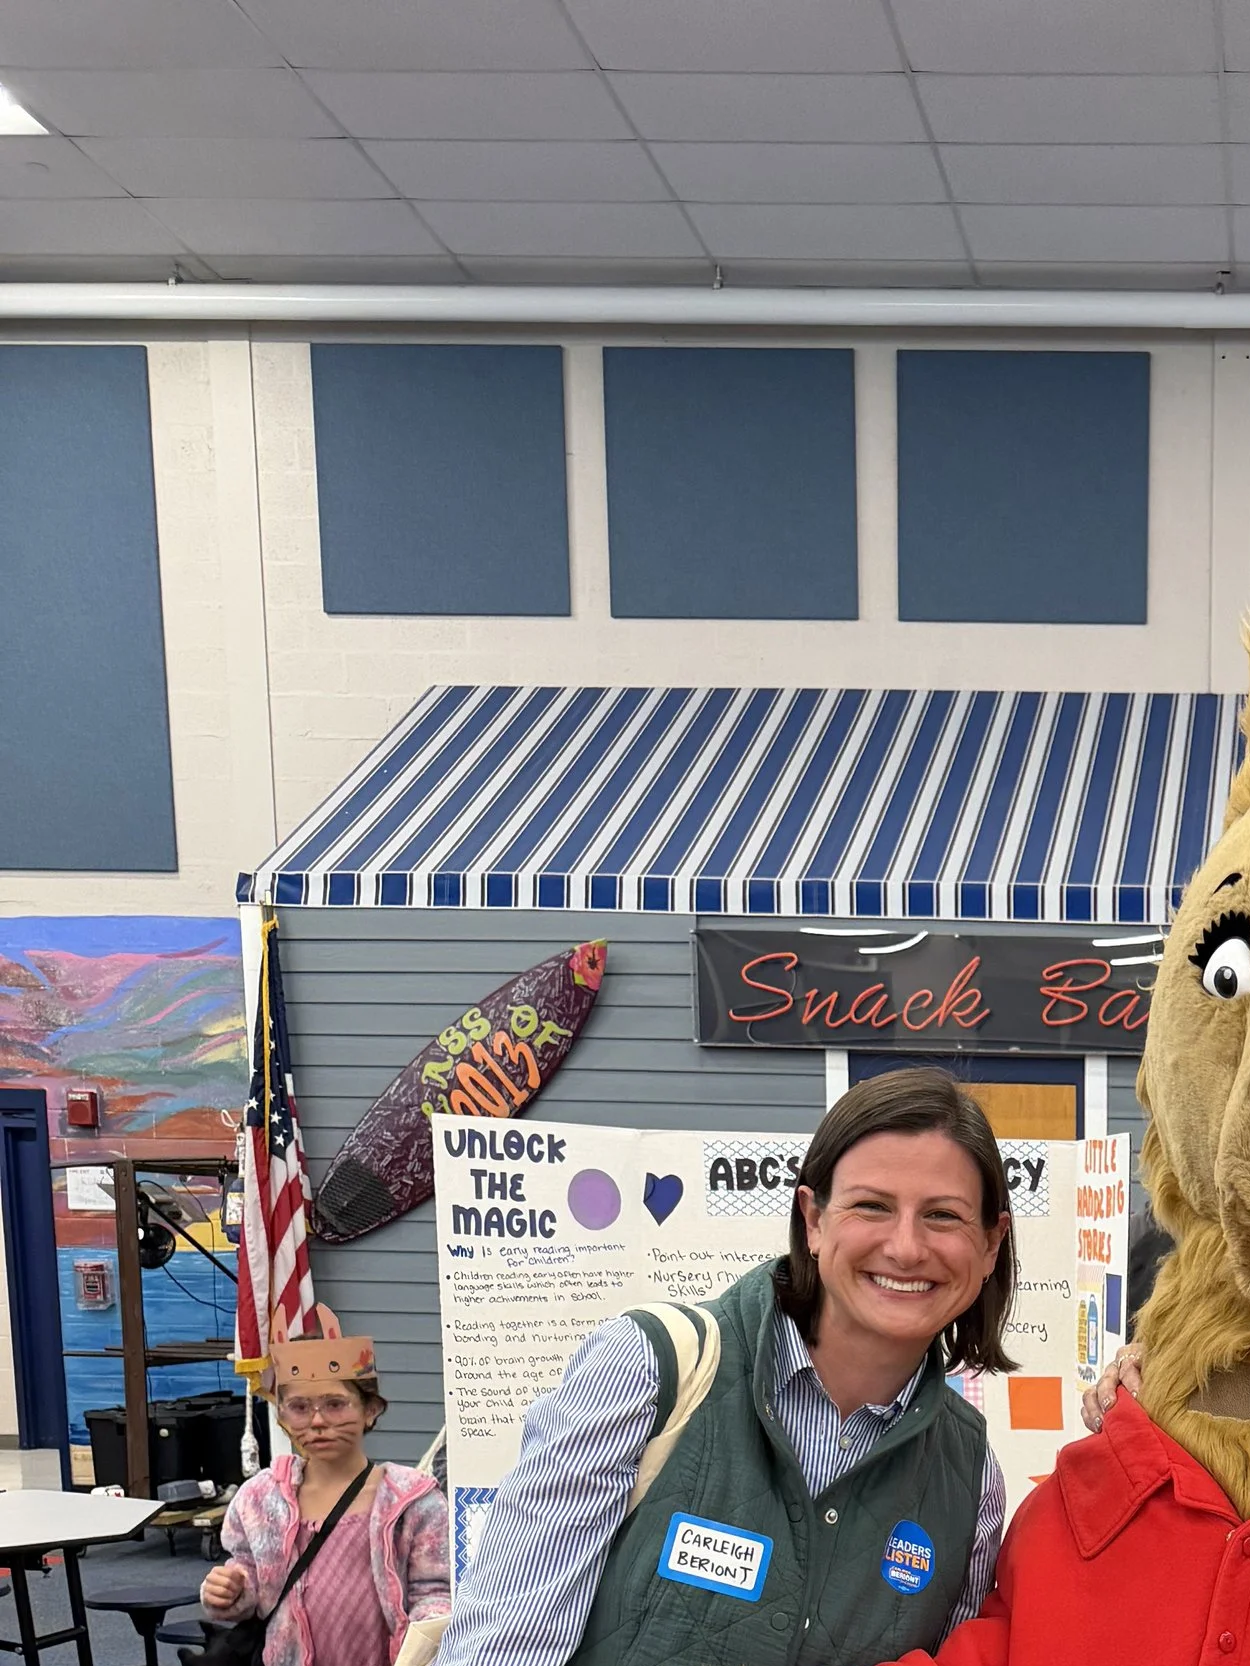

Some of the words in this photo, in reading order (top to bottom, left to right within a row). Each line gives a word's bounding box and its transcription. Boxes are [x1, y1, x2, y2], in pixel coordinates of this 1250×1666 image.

[729, 952, 991, 1031] Snack
[1039, 958, 1149, 1031] Ba
[421, 1007, 491, 1118] ASS
[506, 1004, 573, 1049] OF
[444, 1128, 567, 1164] UNLOCK
[1085, 1139, 1117, 1174] LITTLE
[470, 1168, 526, 1202] THE
[1106, 1179, 1124, 1218] BIG
[452, 1204, 557, 1239] MAGIC
[447, 1244, 474, 1259] Why
[500, 1246, 528, 1259] early
[533, 1245, 571, 1257] reading
[575, 1243, 626, 1254] important
[1078, 1228, 1112, 1264] STORIES
[507, 1258, 524, 1268] for
[652, 1248, 686, 1263] Point
[689, 1251, 715, 1260] out
[454, 1271, 494, 1280] Children
[496, 1272, 531, 1282] reading
[533, 1271, 556, 1280] early
[557, 1270, 581, 1278] often
[582, 1270, 602, 1278] have
[605, 1270, 635, 1280] higher
[454, 1283, 494, 1295] language
[497, 1282, 525, 1290] skills
[527, 1280, 555, 1289] which
[559, 1280, 582, 1288] often
[587, 1279, 608, 1288] leads
[611, 1280, 624, 1288] to
[668, 1283, 706, 1297] Skills
[1016, 1279, 1071, 1299] earning
[453, 1293, 485, 1307] higher
[554, 1292, 565, 1301] in
[454, 1319, 495, 1331] Reading
[499, 1320, 544, 1331] together
[571, 1318, 595, 1326] form
[1006, 1322, 1048, 1342] ocery
[453, 1333, 498, 1347] bonding
[505, 1333, 526, 1342] and
[494, 1356, 525, 1365] brain
[528, 1354, 564, 1367] growth
[497, 1370, 517, 1379] the
[522, 1371, 544, 1382] age
[549, 1367, 562, 1376] of
[456, 1387, 477, 1396] The
[516, 1386, 528, 1395] of
[457, 1399, 480, 1412] your
[459, 1415, 486, 1425] brain
[491, 1413, 515, 1424] that
[681, 1529, 755, 1562] CARLEIGH
[889, 1536, 931, 1559] LEADERS
[677, 1551, 754, 1584] BERIONT
[886, 1546, 930, 1571] LISTEN
